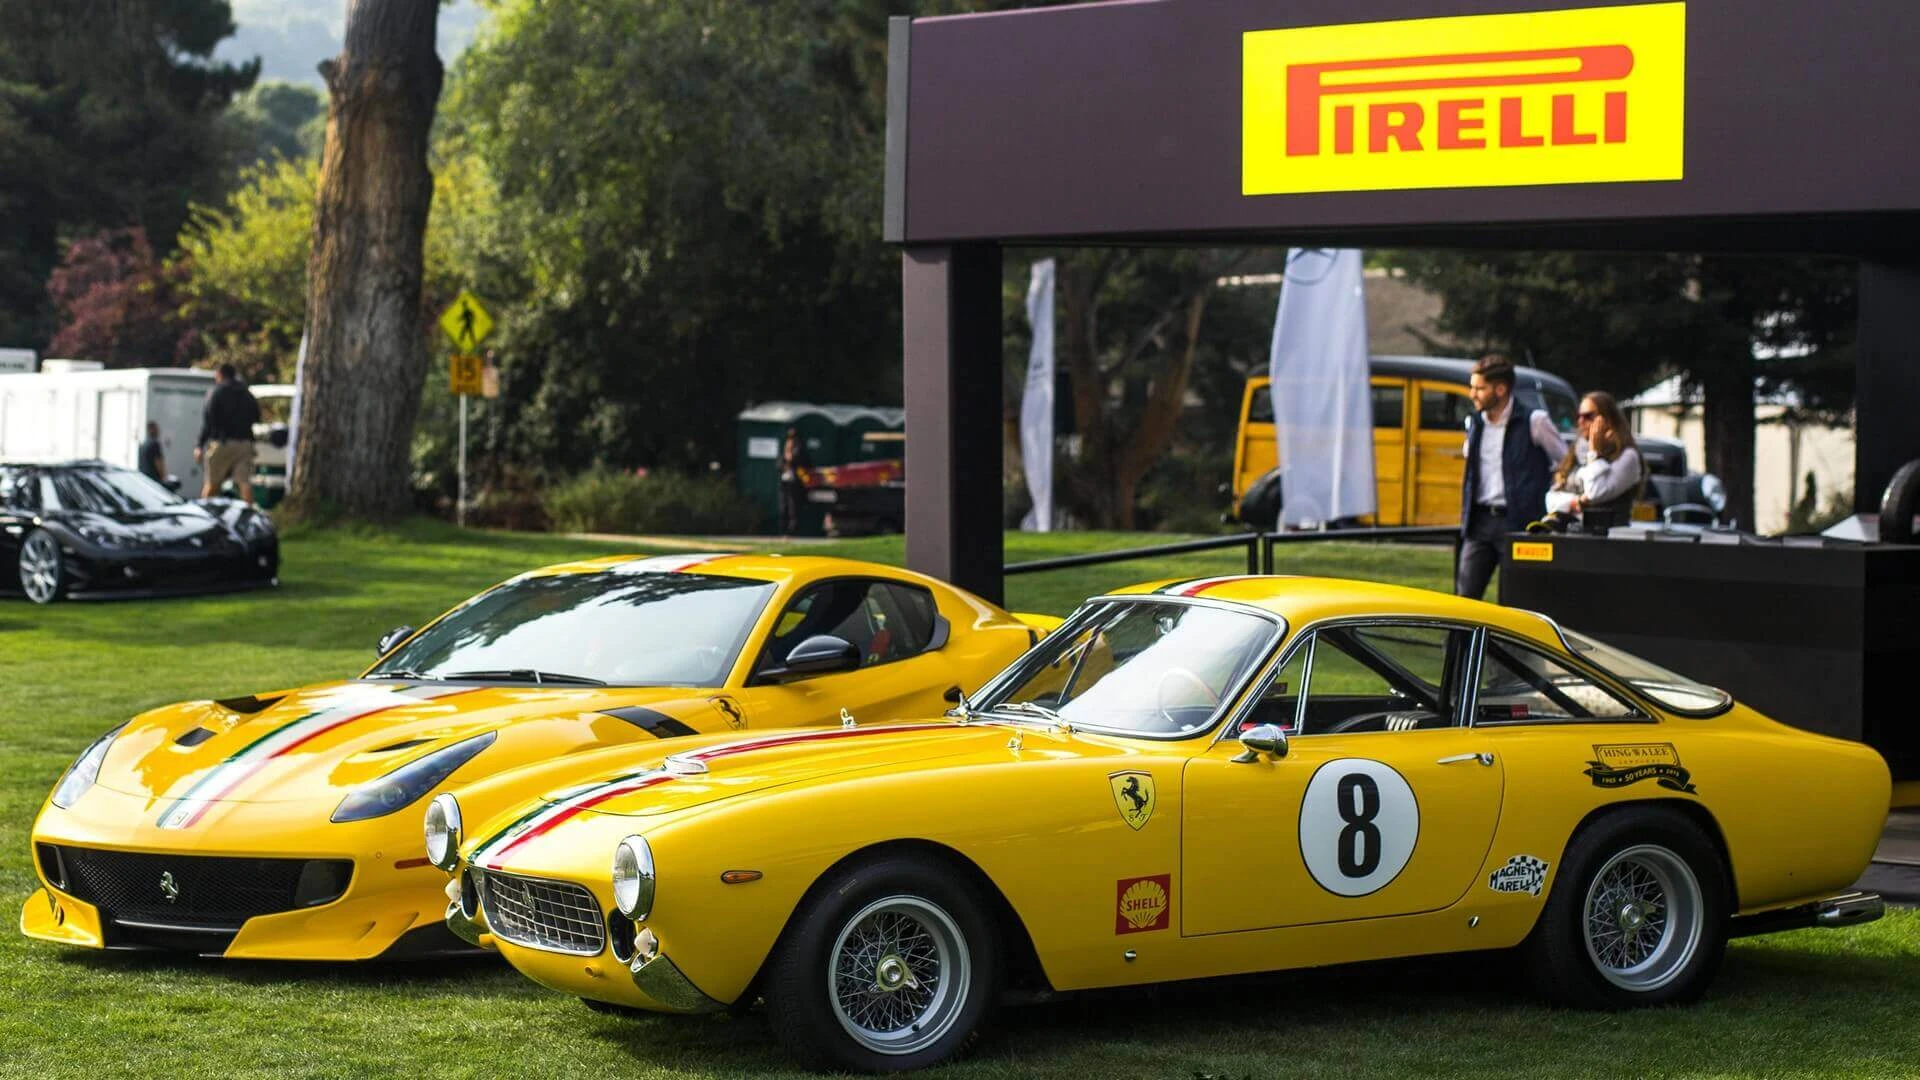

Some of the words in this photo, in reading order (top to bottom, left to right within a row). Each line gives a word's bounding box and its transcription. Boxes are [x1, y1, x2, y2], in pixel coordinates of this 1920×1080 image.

[1285, 44, 1634, 157] PIRELLI
[1635, 767, 1657, 778] YEARS
[1337, 773, 1381, 878] 8
[1126, 898, 1161, 911] SHELL
